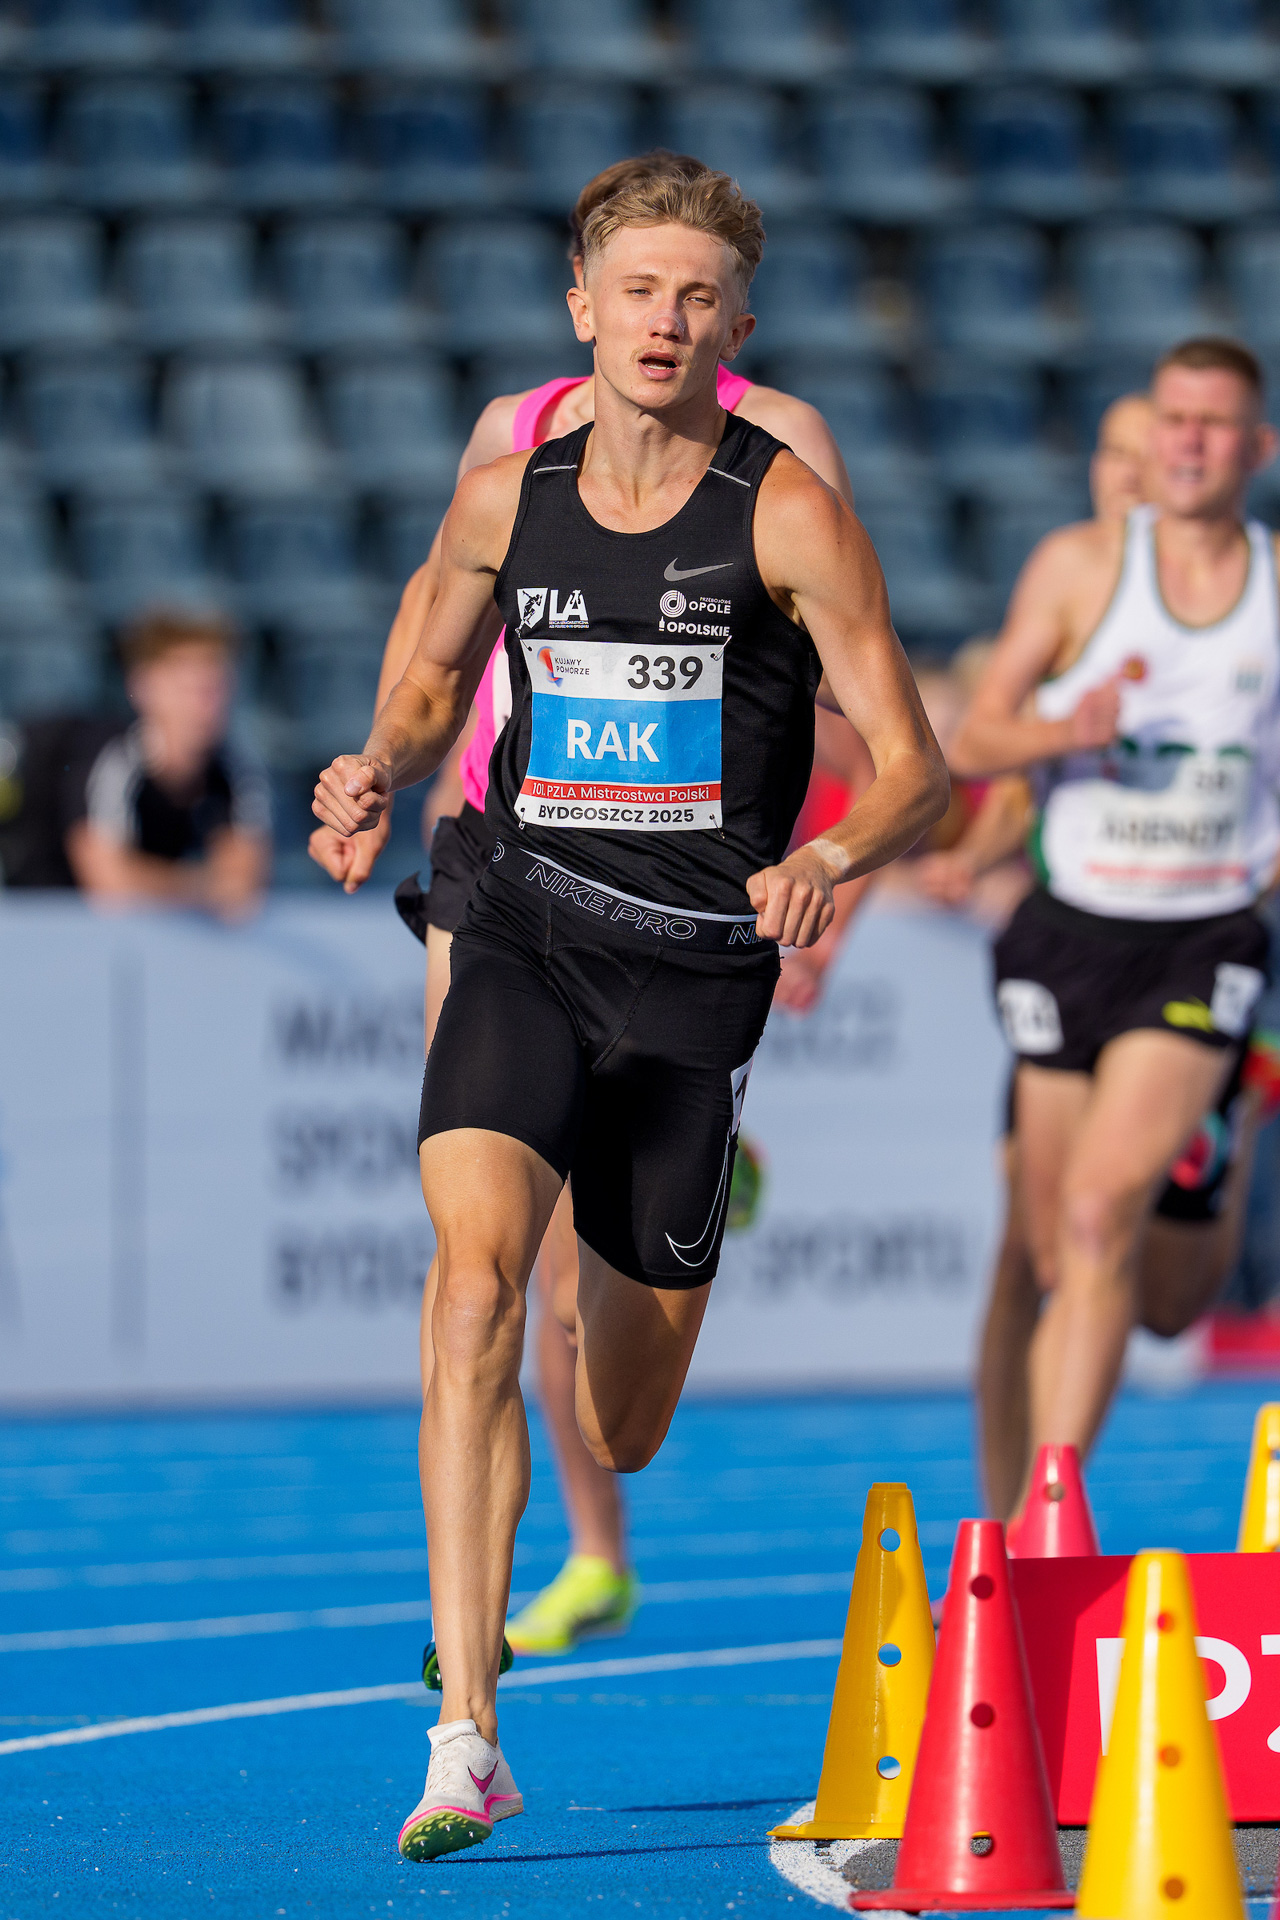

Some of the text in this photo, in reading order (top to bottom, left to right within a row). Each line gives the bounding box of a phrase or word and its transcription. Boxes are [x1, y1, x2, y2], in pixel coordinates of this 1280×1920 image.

[688, 601, 731, 614] OPOLE
[667, 621, 730, 637] OPOLSKIE
[554, 657, 582, 666] KUJAWY
[556, 666, 590, 675] POMORZE
[627, 654, 703, 691] 339
[567, 719, 660, 762] RAK
[532, 782, 710, 802] 101. PZLA Mistrzostwa Polski
[538, 805, 695, 823] BYDGOSZCZ 2025
[525, 862, 613, 916] NIKE
[610, 902, 697, 939] PRO
